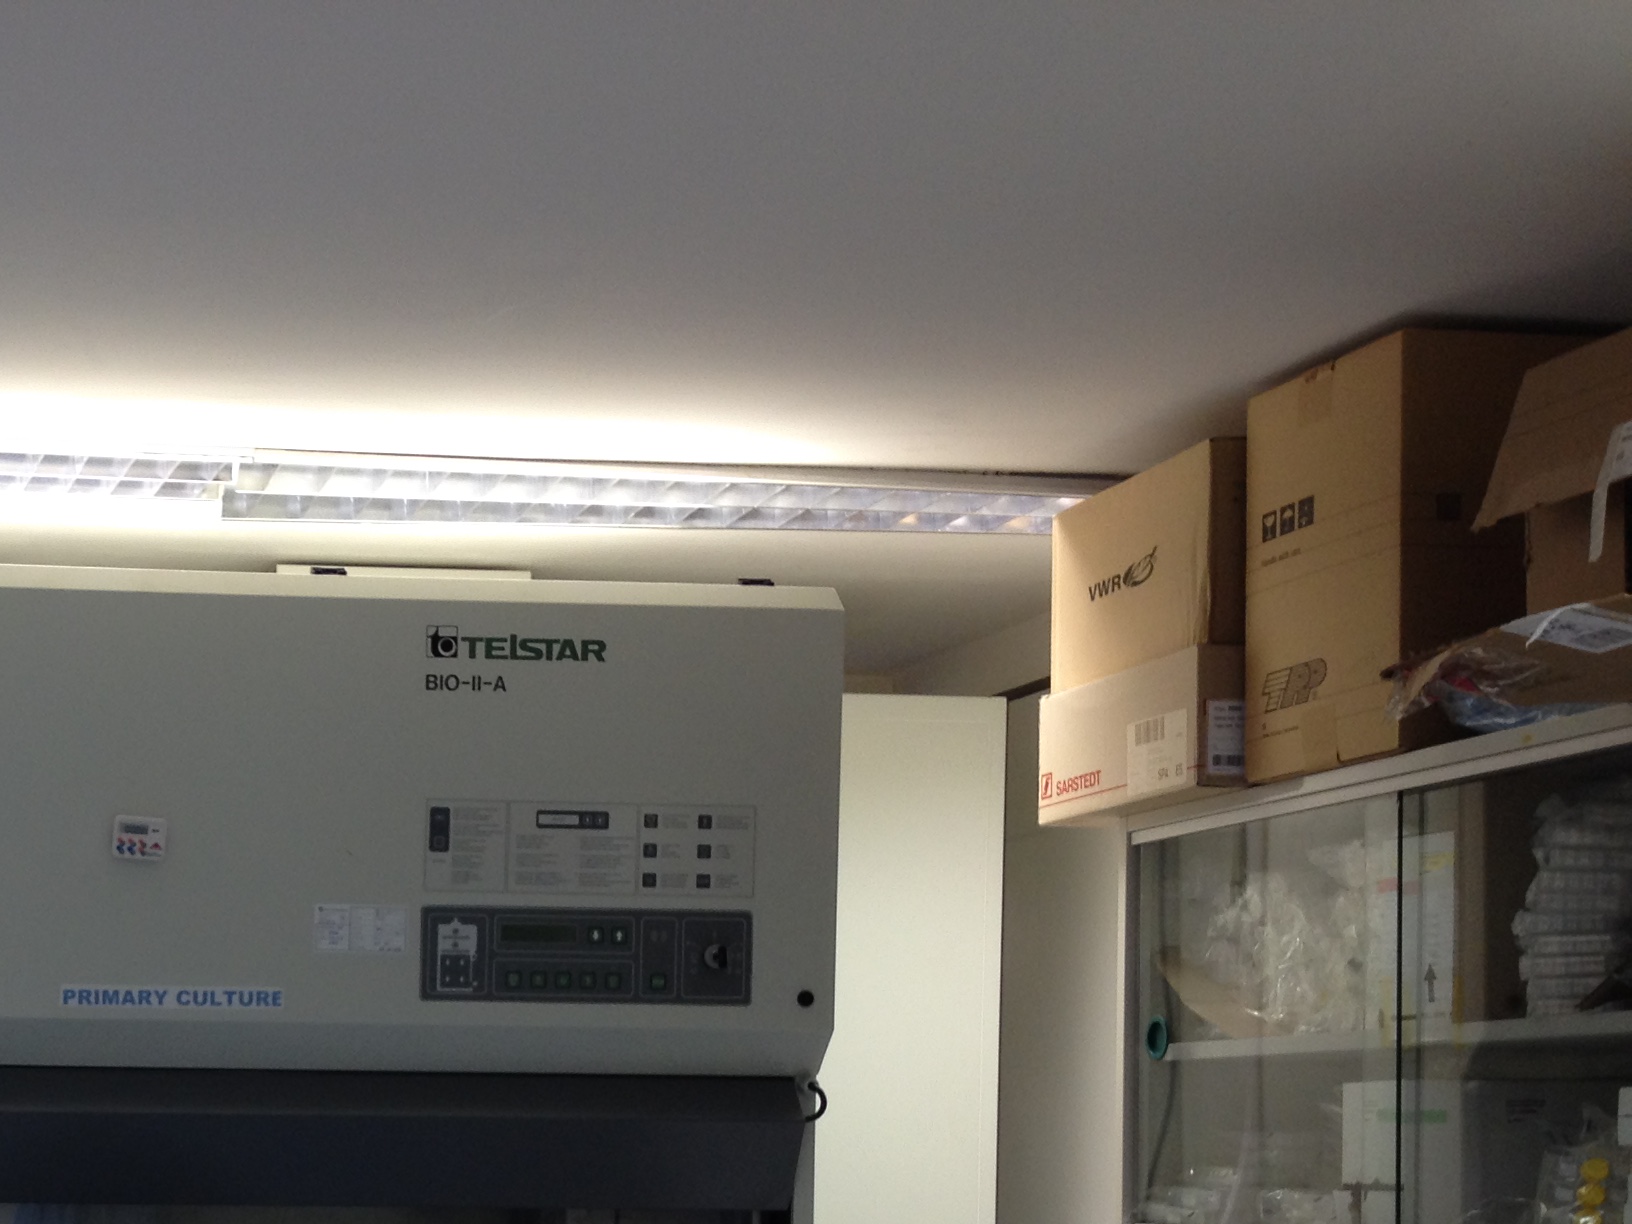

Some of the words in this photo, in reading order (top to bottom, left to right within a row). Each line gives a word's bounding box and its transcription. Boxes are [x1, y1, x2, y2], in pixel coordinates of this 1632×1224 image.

[1088, 573, 1121, 602] VWR
[461, 634, 607, 662] TELSTAR
[425, 674, 507, 692] BIO-II-A
[1056, 769, 1102, 796] SARSTEDT
[63, 989, 167, 1006] PRIMARY
[176, 990, 283, 1007] CULTURE
